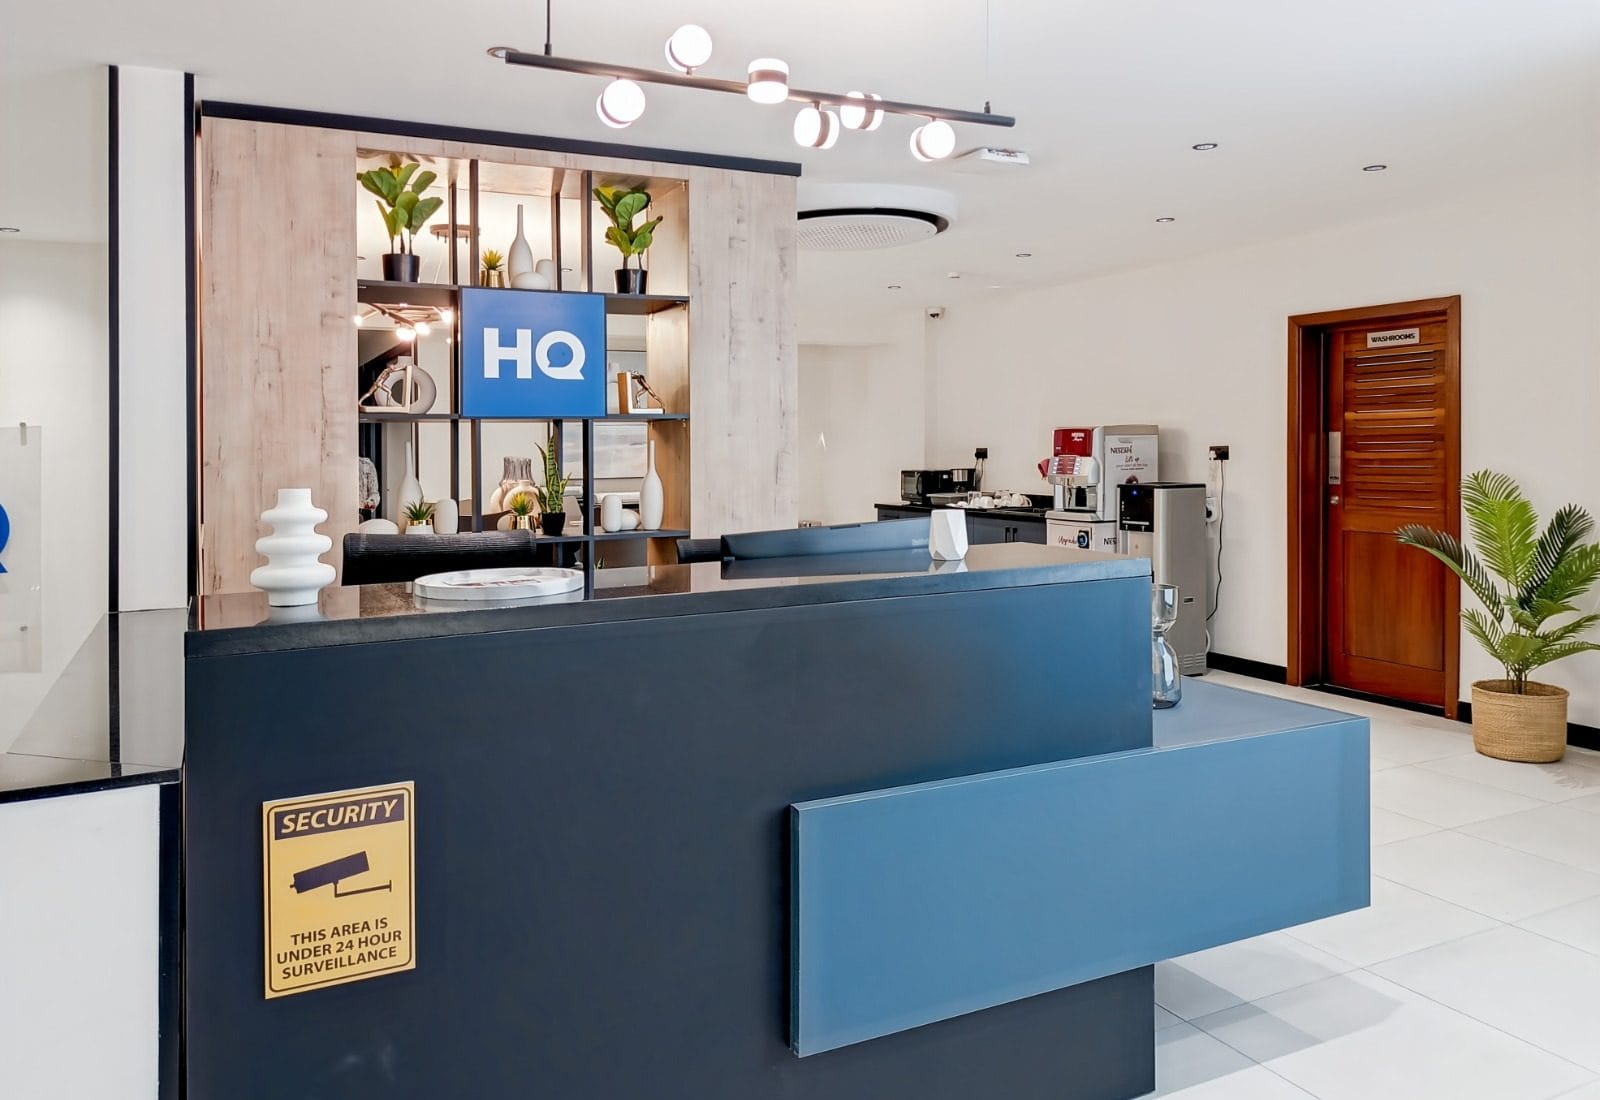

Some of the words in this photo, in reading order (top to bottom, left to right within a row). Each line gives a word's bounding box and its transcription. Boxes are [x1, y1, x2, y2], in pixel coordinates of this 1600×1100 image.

[483, 327, 586, 380] HQ
[1371, 333, 1416, 342] WASHROOMS
[280, 798, 399, 834] SECURITY
[276, 941, 332, 965] UNDER
[335, 939, 354, 954] 24
[358, 930, 402, 949] HOUR
[290, 929, 326, 946] THIS
[330, 920, 371, 939] AREA
[374, 917, 389, 929] IS
[282, 946, 397, 980] SURVEILLANCE
